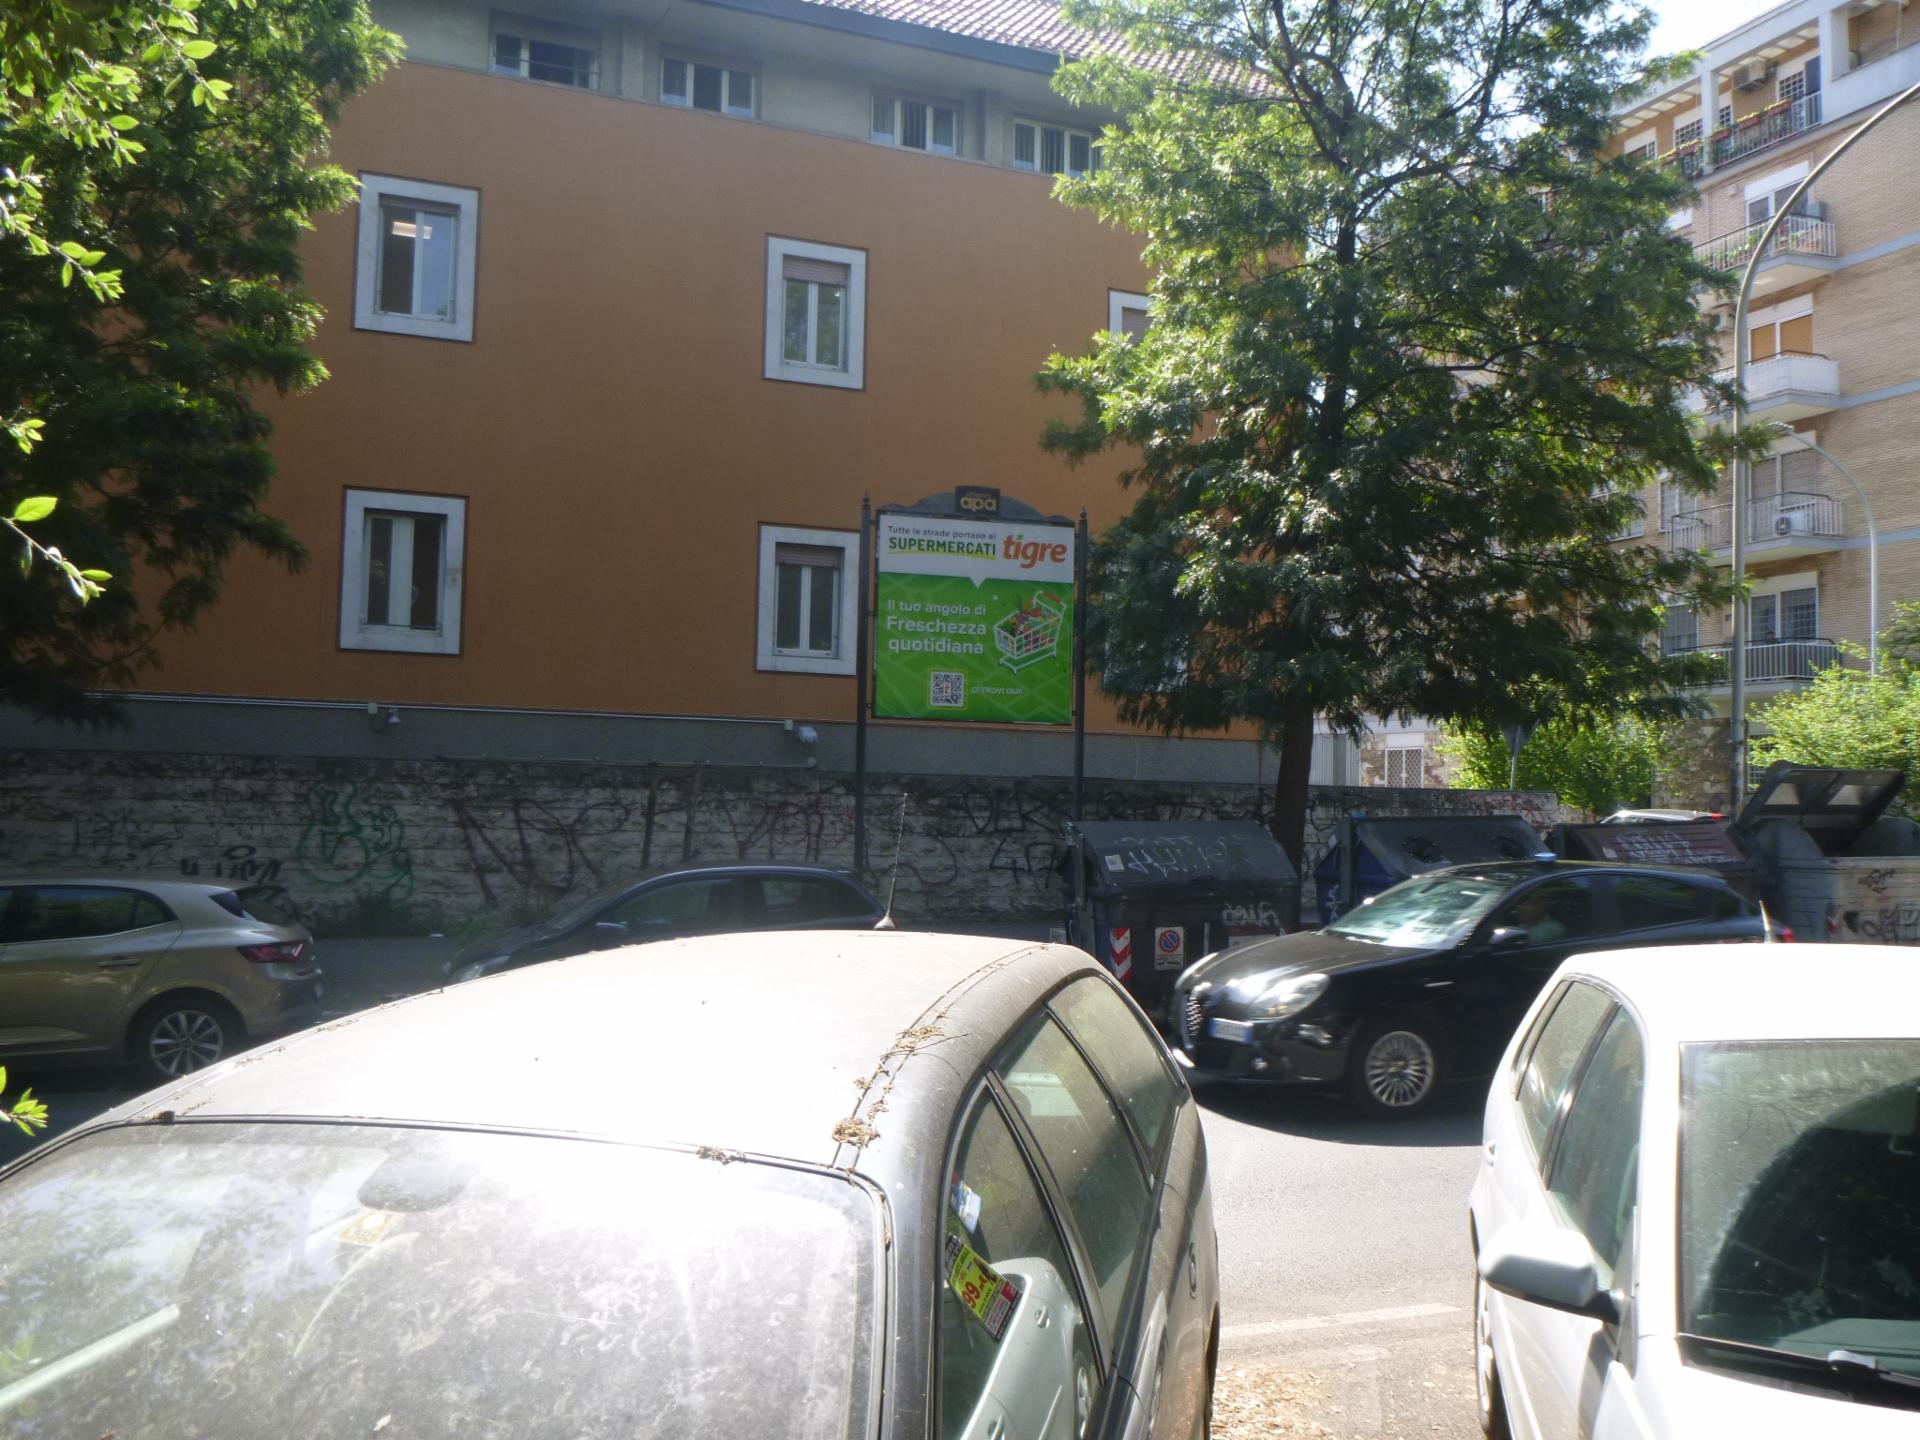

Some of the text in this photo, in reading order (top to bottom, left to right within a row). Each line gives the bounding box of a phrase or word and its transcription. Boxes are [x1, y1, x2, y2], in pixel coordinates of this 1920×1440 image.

[888, 525, 911, 535] Tutte
[913, 527, 921, 535] le
[923, 528, 950, 537] strade
[953, 530, 985, 540] portano
[889, 536, 996, 556] SUPERMERCATI
[1003, 533, 1067, 569] tigre
[888, 600, 986, 616] Il tuo angolo di
[886, 616, 986, 636] Freschezza
[889, 637, 984, 655] quotidiana
